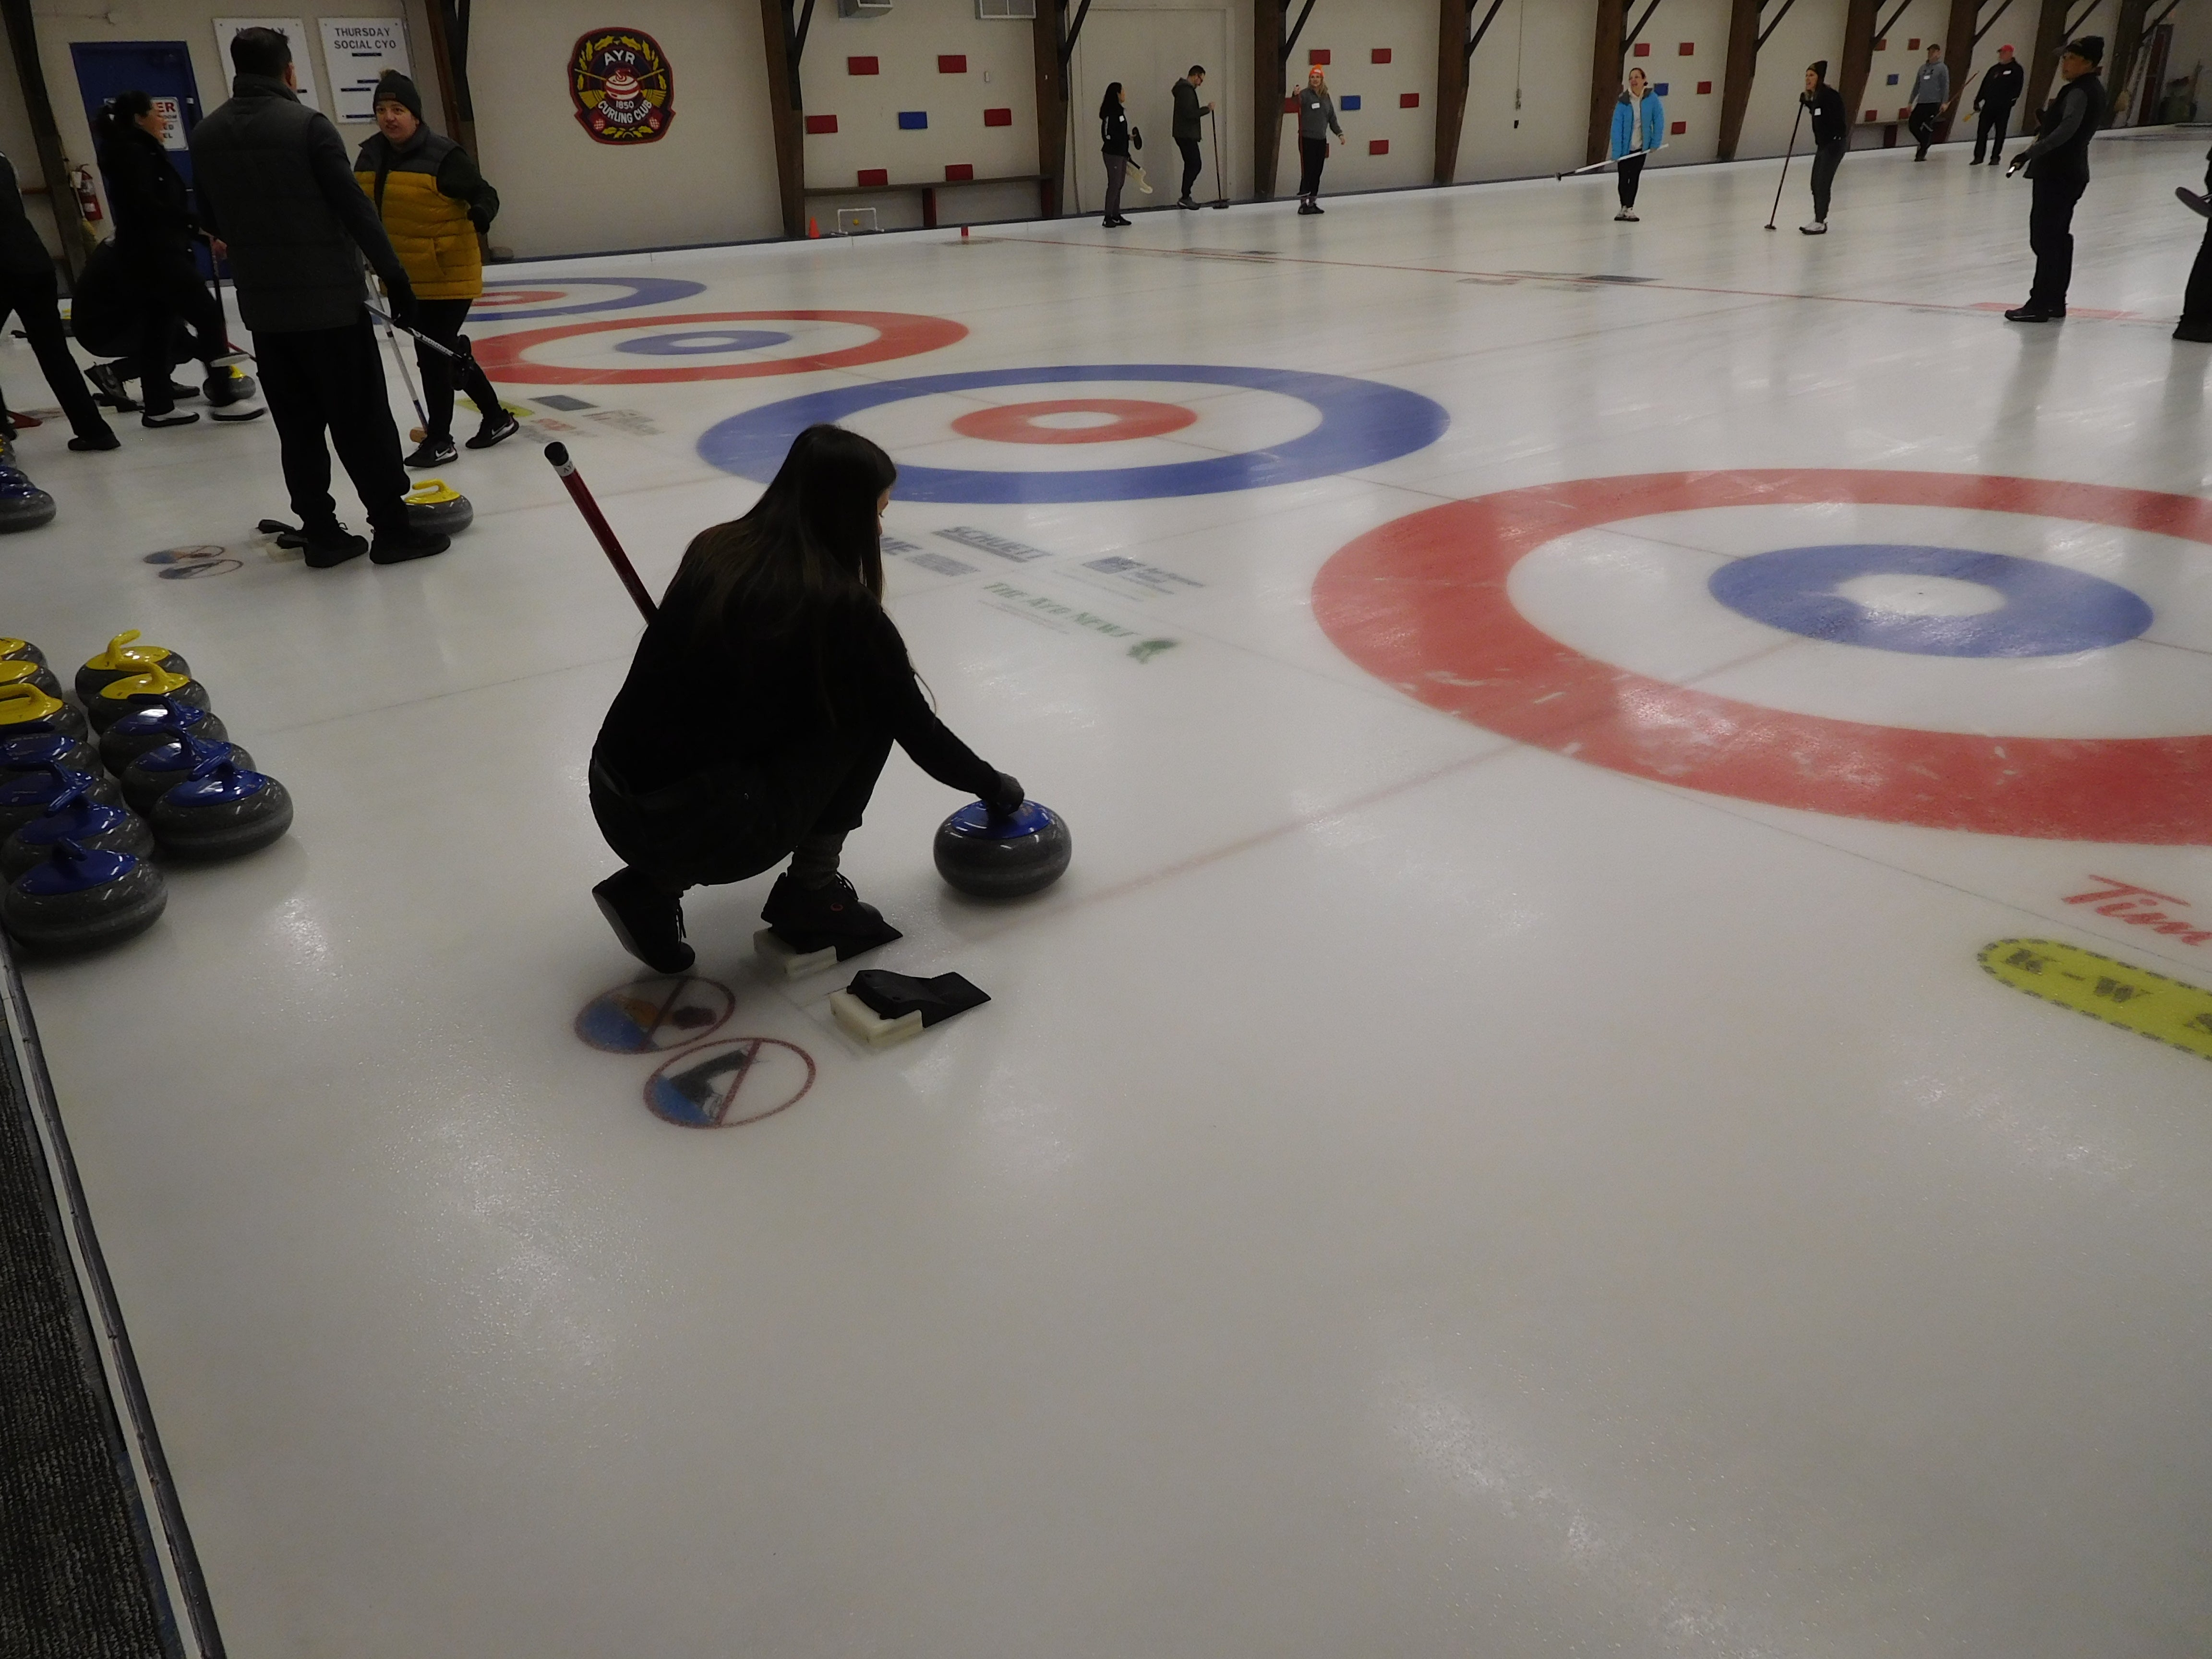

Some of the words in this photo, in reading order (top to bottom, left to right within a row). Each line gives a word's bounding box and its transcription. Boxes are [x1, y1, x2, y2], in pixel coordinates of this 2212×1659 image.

[335, 27, 390, 36] THURSDAY
[334, 40, 372, 49] SOCIAL
[375, 40, 397, 48] CYO
[604, 49, 636, 66] AYR
[616, 100, 634, 109] 1850
[598, 100, 633, 124] CURLING
[633, 99, 653, 121] CLUB
